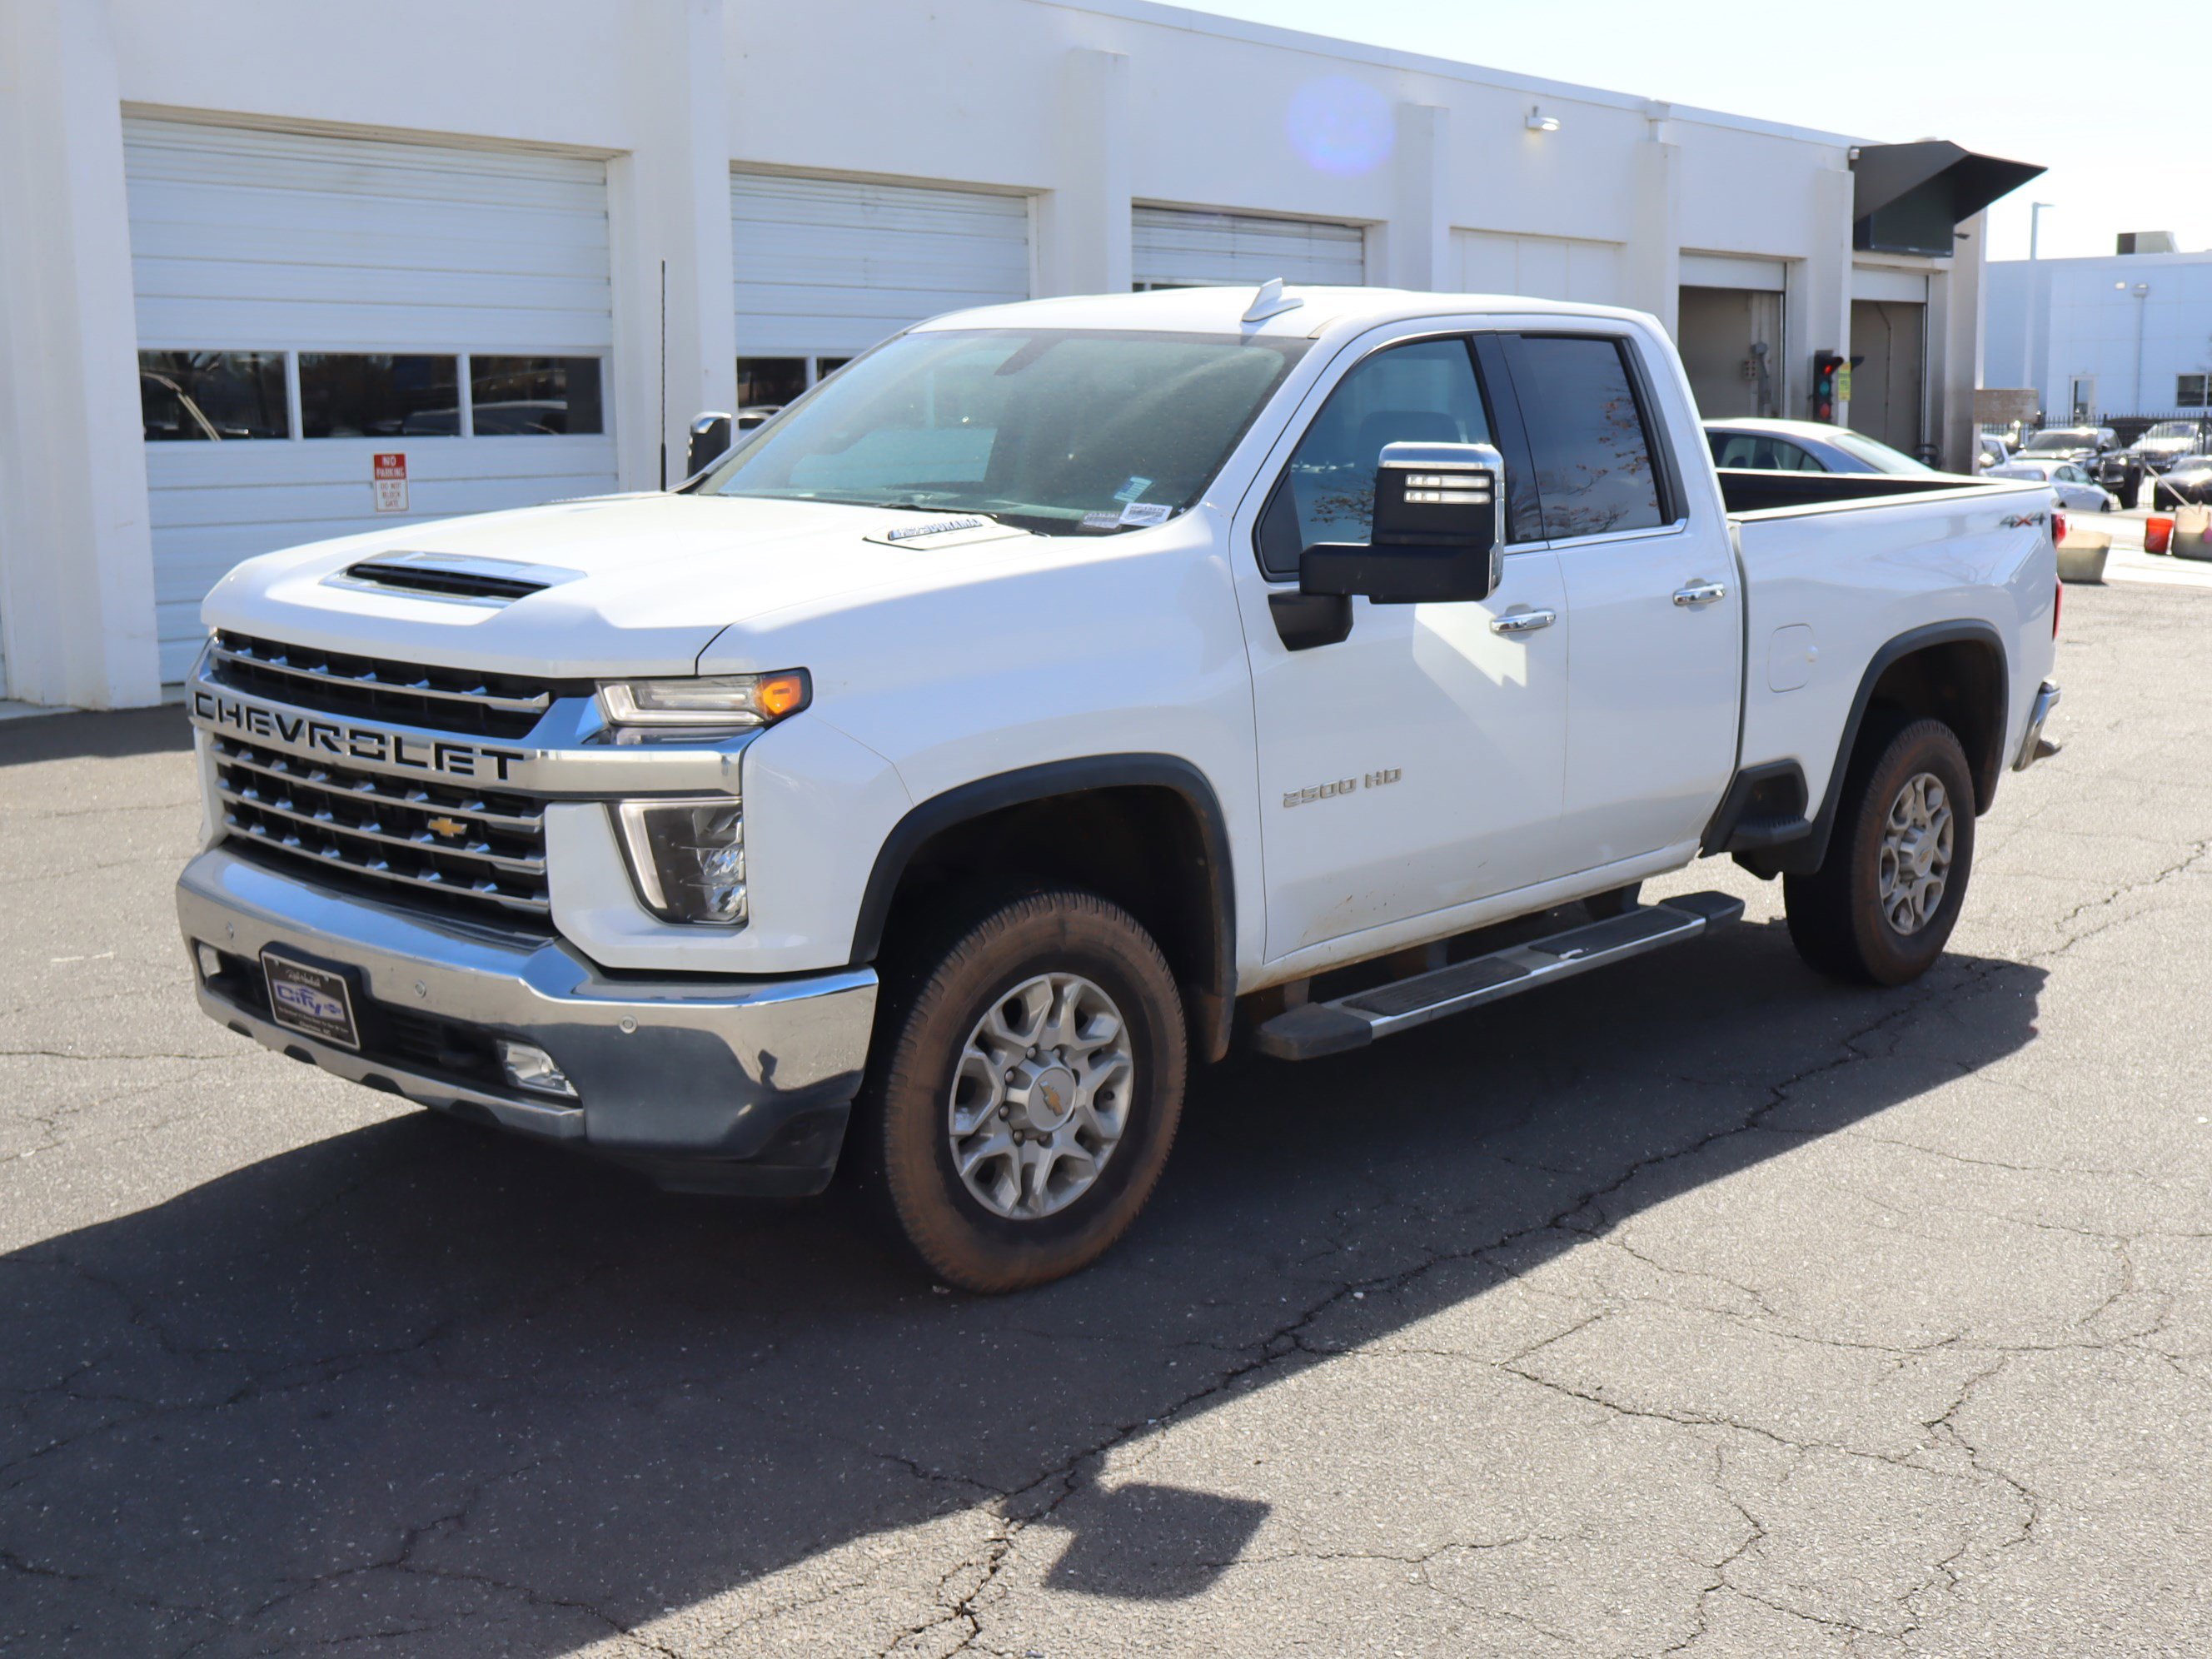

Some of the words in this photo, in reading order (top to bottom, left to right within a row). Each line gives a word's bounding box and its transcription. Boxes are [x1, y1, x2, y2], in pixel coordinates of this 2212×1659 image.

[376, 468, 405, 478] PARKING
[382, 456, 397, 466] NO
[193, 692, 525, 781] CHEVROLET
[1283, 777, 1357, 808] 2500
[1365, 766, 1402, 789] HD
